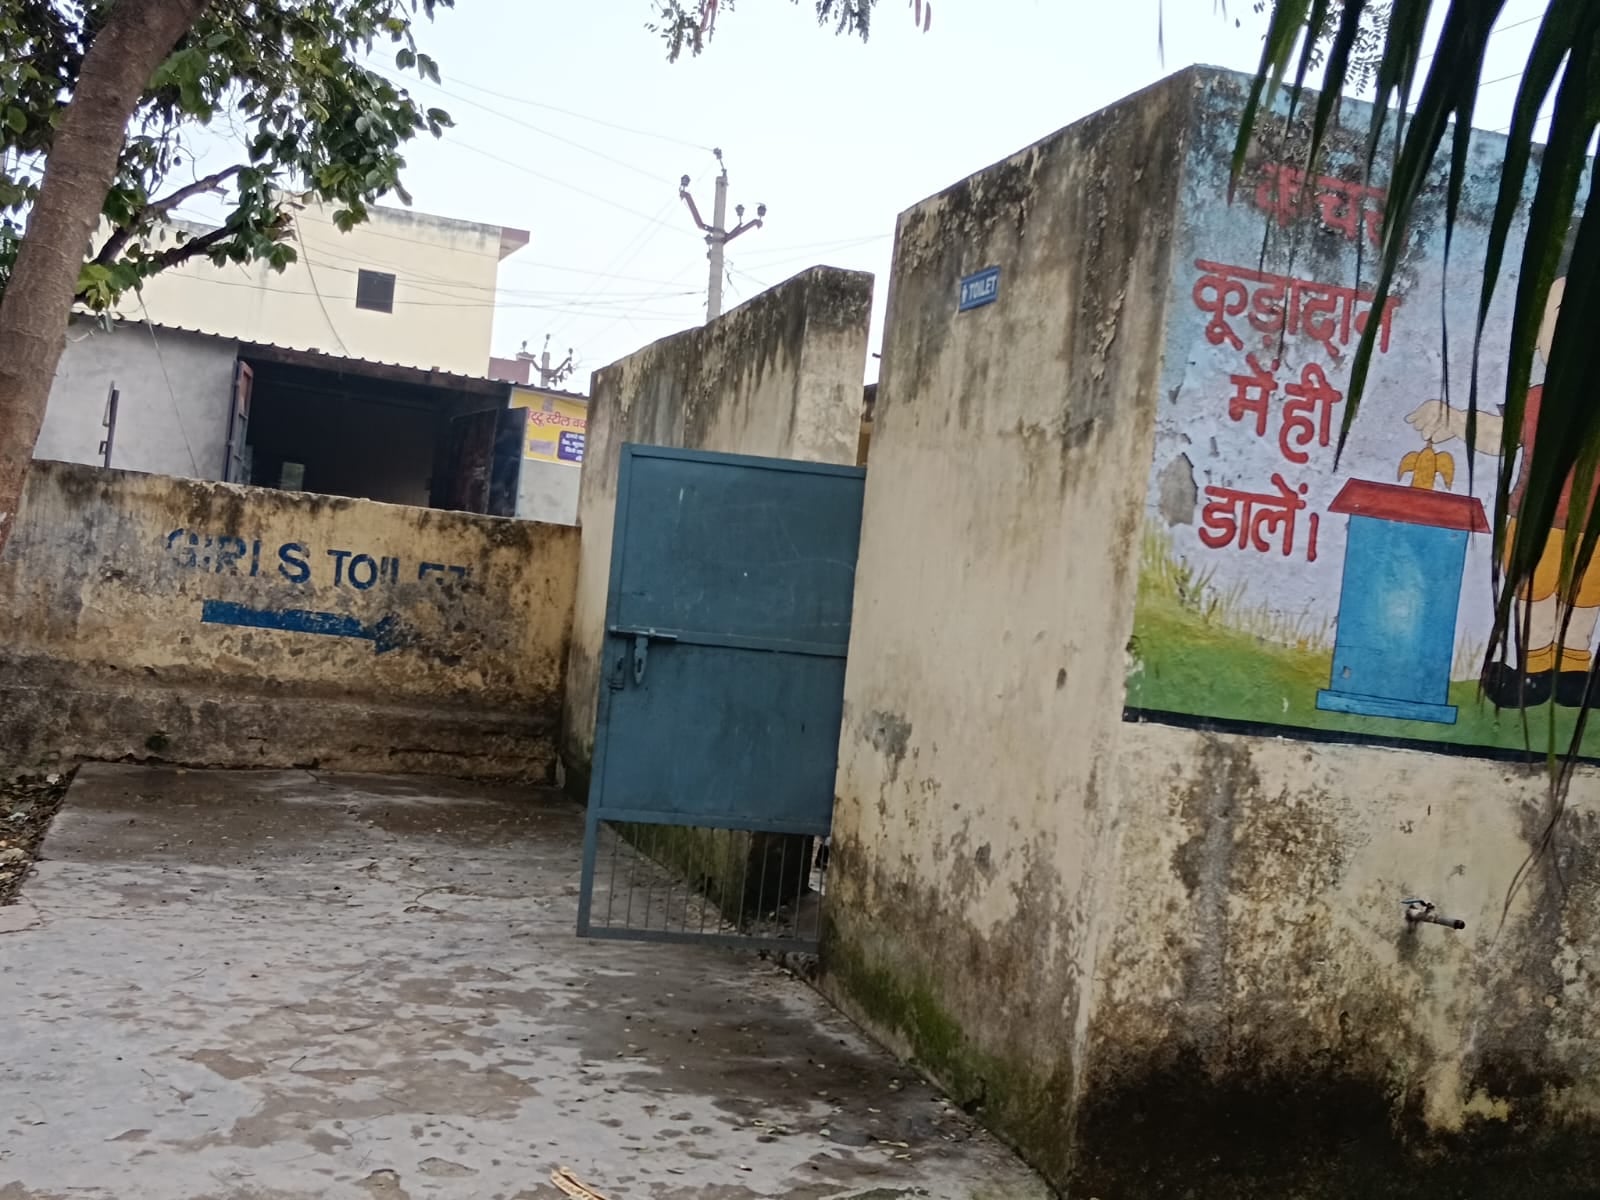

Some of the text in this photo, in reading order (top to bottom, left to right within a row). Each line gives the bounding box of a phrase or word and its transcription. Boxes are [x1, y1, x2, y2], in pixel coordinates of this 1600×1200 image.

[968, 275, 998, 301] TOILET
[1229, 353, 1343, 464] में ही
